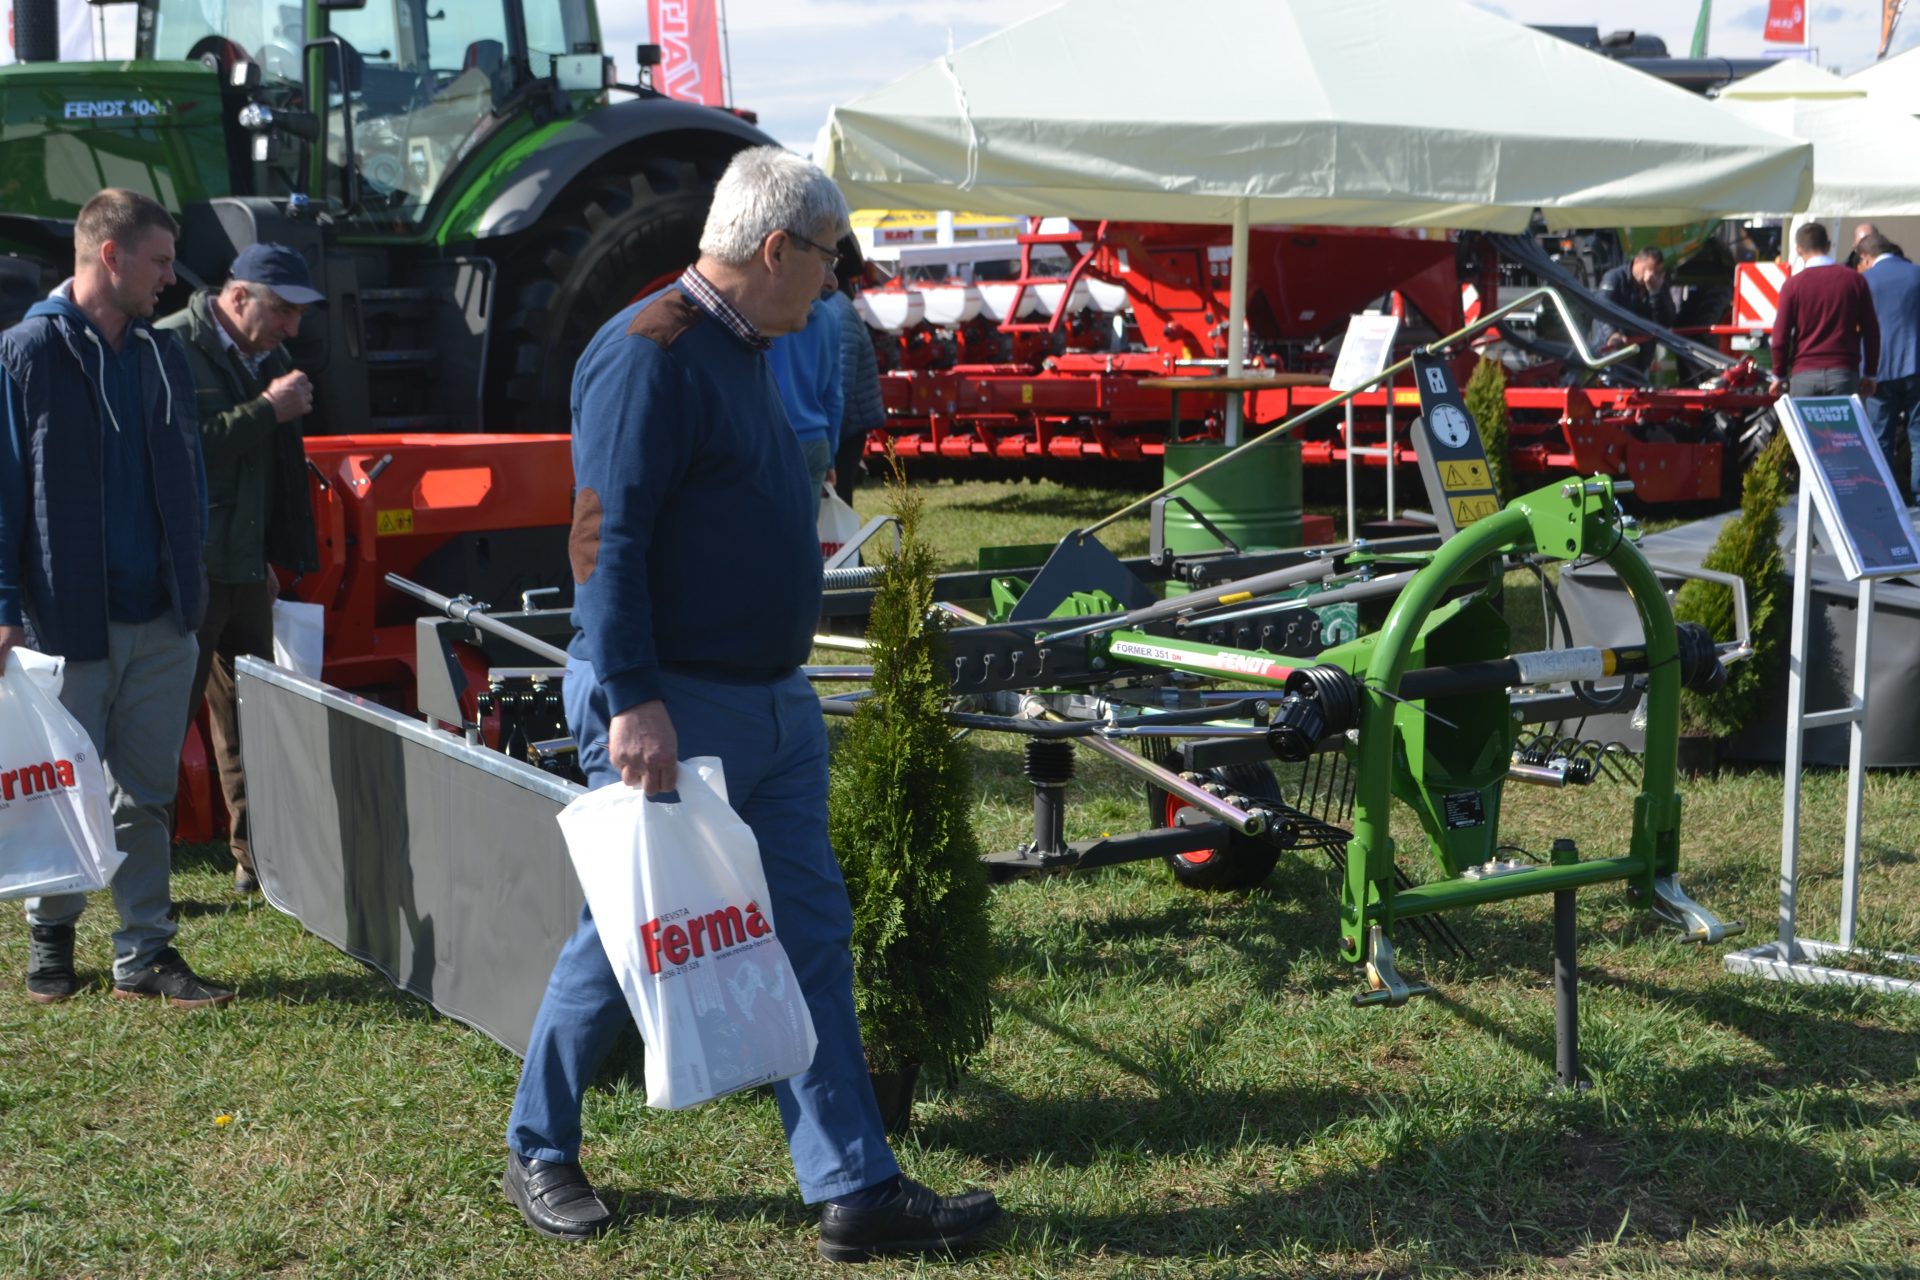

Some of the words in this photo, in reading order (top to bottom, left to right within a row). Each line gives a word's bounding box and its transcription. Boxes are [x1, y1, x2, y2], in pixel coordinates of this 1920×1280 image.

[64, 101, 126, 119] FENDT
[1801, 405, 1850, 422] FENDT
[1116, 643, 1152, 657] FORMER
[1154, 649, 1169, 660] 351
[1215, 651, 1276, 674] FENDT
[0, 759, 76, 801] rma
[660, 907, 690, 922] REVISTA
